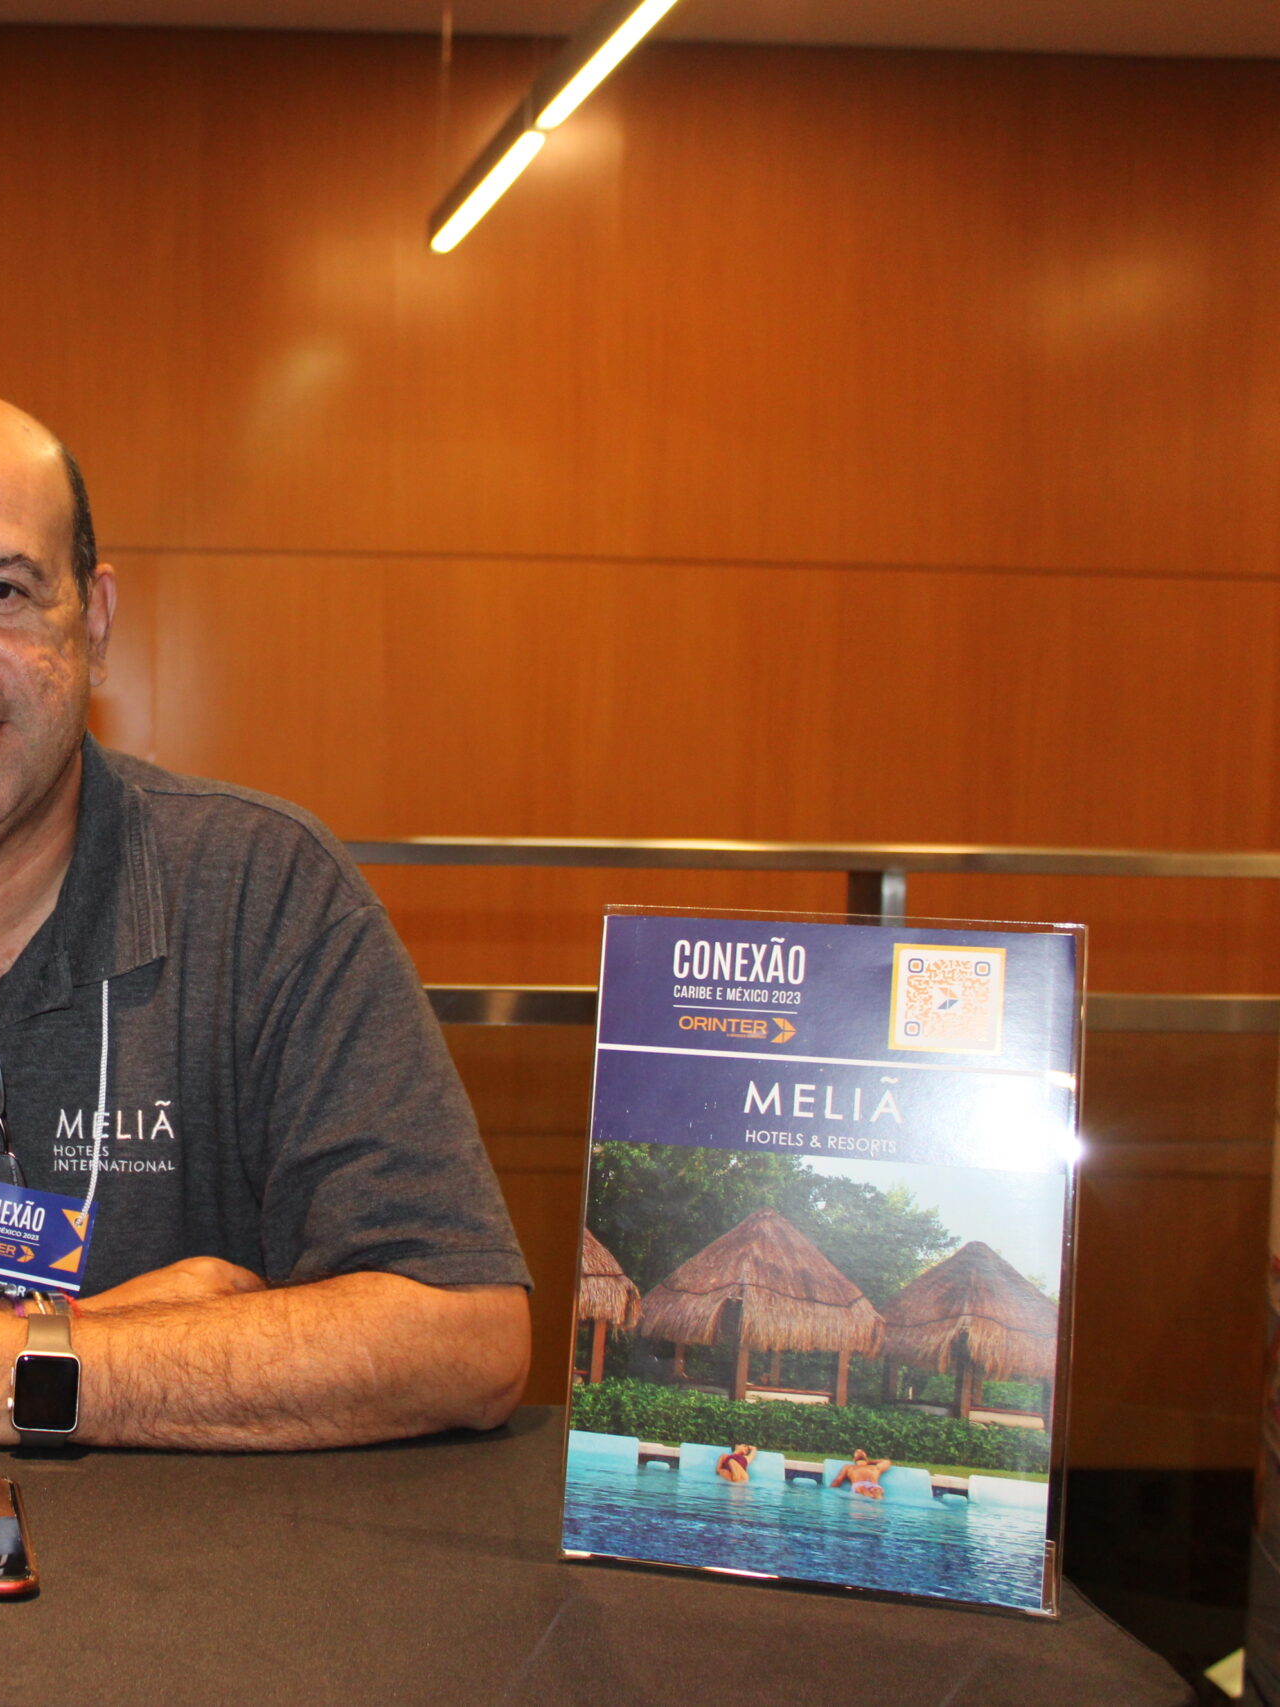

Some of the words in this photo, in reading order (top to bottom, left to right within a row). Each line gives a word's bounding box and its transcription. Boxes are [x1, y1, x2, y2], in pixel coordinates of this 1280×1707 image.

[673, 937, 806, 985] CONEXÃO
[673, 985, 713, 1000] CARIBE
[716, 987, 723, 1000] E
[726, 987, 769, 1003] MÉXICO
[771, 990, 801, 1005] 2023
[679, 1016, 768, 1035] ORINTER
[743, 1076, 905, 1124] MELIÃ
[56, 1100, 175, 1140] MELIÃ
[745, 1130, 804, 1148] HOTELS
[809, 1135, 821, 1149] &
[827, 1135, 897, 1153] RESORTS
[22, 1232, 40, 1241] 2023
